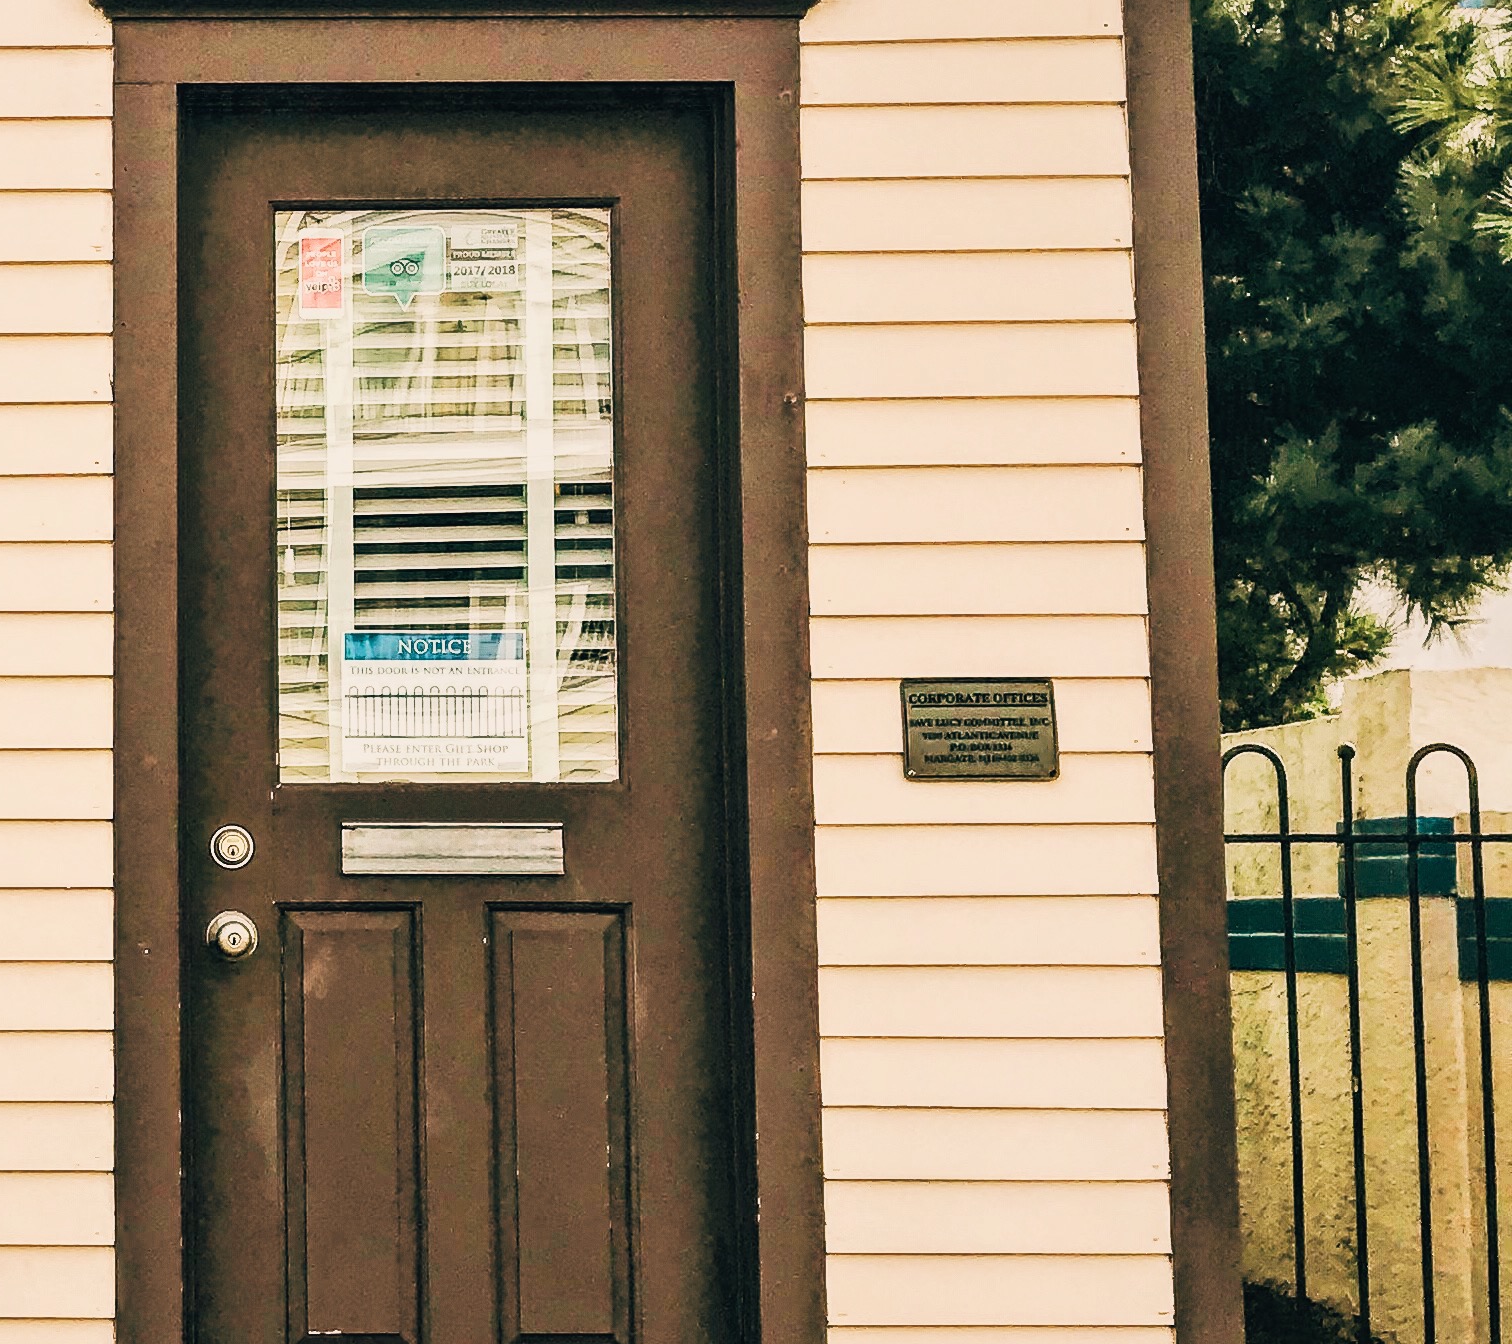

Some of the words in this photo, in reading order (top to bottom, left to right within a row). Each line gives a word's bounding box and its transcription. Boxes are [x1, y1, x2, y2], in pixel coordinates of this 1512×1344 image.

[397, 638, 472, 655] NOTICE
[350, 665, 374, 675] THIS
[377, 665, 408, 675] DOOR
[411, 665, 420, 675] IS
[423, 665, 447, 675] NOT
[449, 665, 463, 675] AN
[467, 665, 520, 675] ENTRANCE
[908, 692, 990, 704] CORPORATE
[992, 692, 1049, 704] OFFICES
[935, 718, 962, 727] LUCY
[944, 731, 999, 740] ATLANTIC
[999, 730, 1039, 740] AVENUE
[362, 743, 402, 754] PLEASE
[406, 744, 442, 753] ENTER
[445, 743, 473, 754] GIFT
[477, 743, 509, 754] SHOP
[376, 757, 435, 767] THROUGH
[440, 757, 461, 767] THE
[466, 757, 496, 767] PARK
